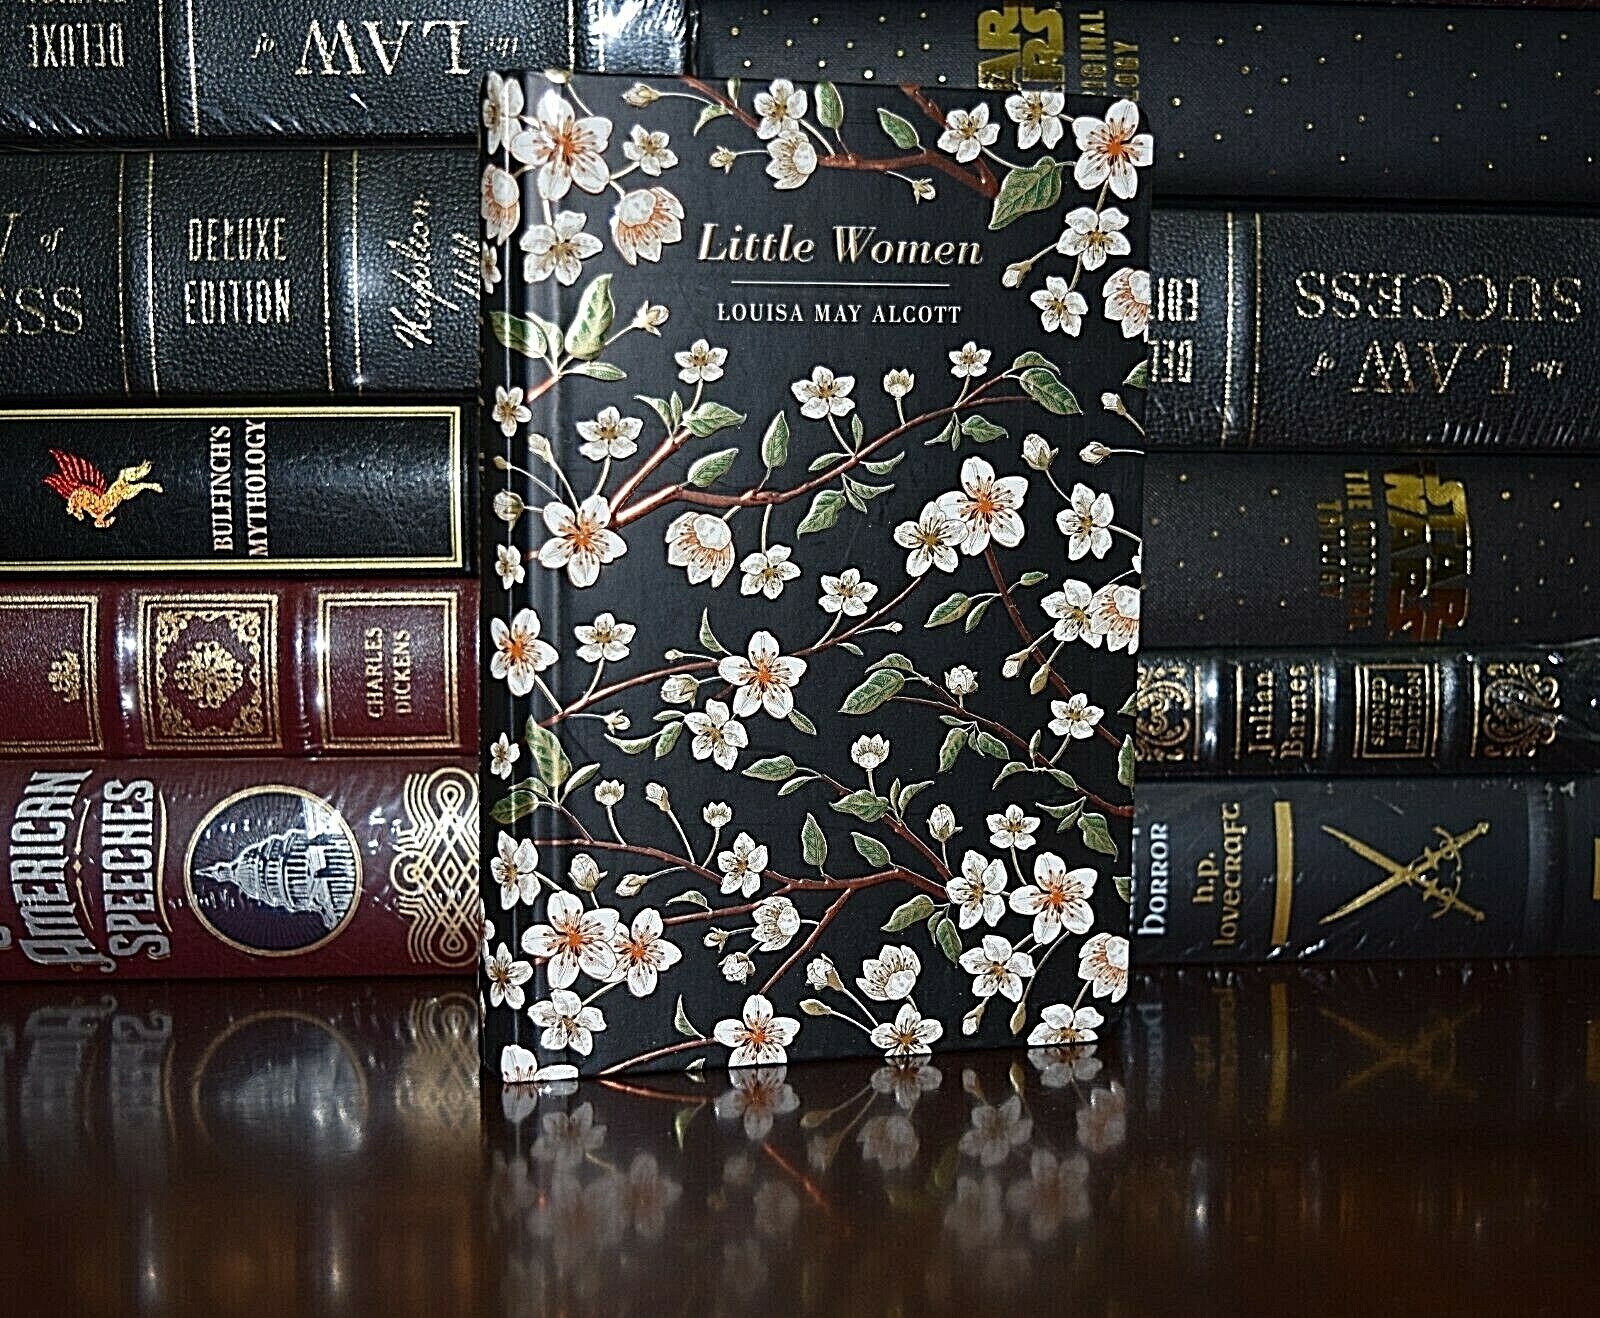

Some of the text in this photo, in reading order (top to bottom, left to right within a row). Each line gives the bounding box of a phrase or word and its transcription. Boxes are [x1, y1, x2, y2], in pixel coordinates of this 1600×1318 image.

[26, 22, 125, 68] DELUXE
[295, 19, 471, 75] LAW
[977, 3, 1021, 91] AR
[1021, 3, 1065, 92] RS
[1079, 10, 1107, 96] IGINAL
[1113, 41, 1139, 101] LOGY
[187, 217, 287, 262] DELUXE
[697, 223, 984, 266] Little Women
[184, 279, 292, 325] EDITION
[717, 303, 961, 324] LOUISA MAY ALCOTT
[1295, 271, 1582, 323] SUCCESS
[1147, 339, 1193, 384] DEL
[1350, 339, 1515, 395] LAW
[210, 425, 234, 552] BULFINCH'S
[245, 418, 269, 557] MYTHOLOGY
[1344, 469, 1373, 510] THE
[364, 626, 384, 718] CHARLES
[394, 628, 412, 714] DICKENS
[1247, 669, 1277, 758] Julian
[1279, 664, 1308, 760] Barnes
[1371, 675, 1387, 747] SIGNED
[1389, 683, 1405, 738] FIRST
[1406, 670, 1422, 751] EDITION
[10, 769, 117, 973] AMERICAN
[102, 778, 172, 960] SPEECHES
